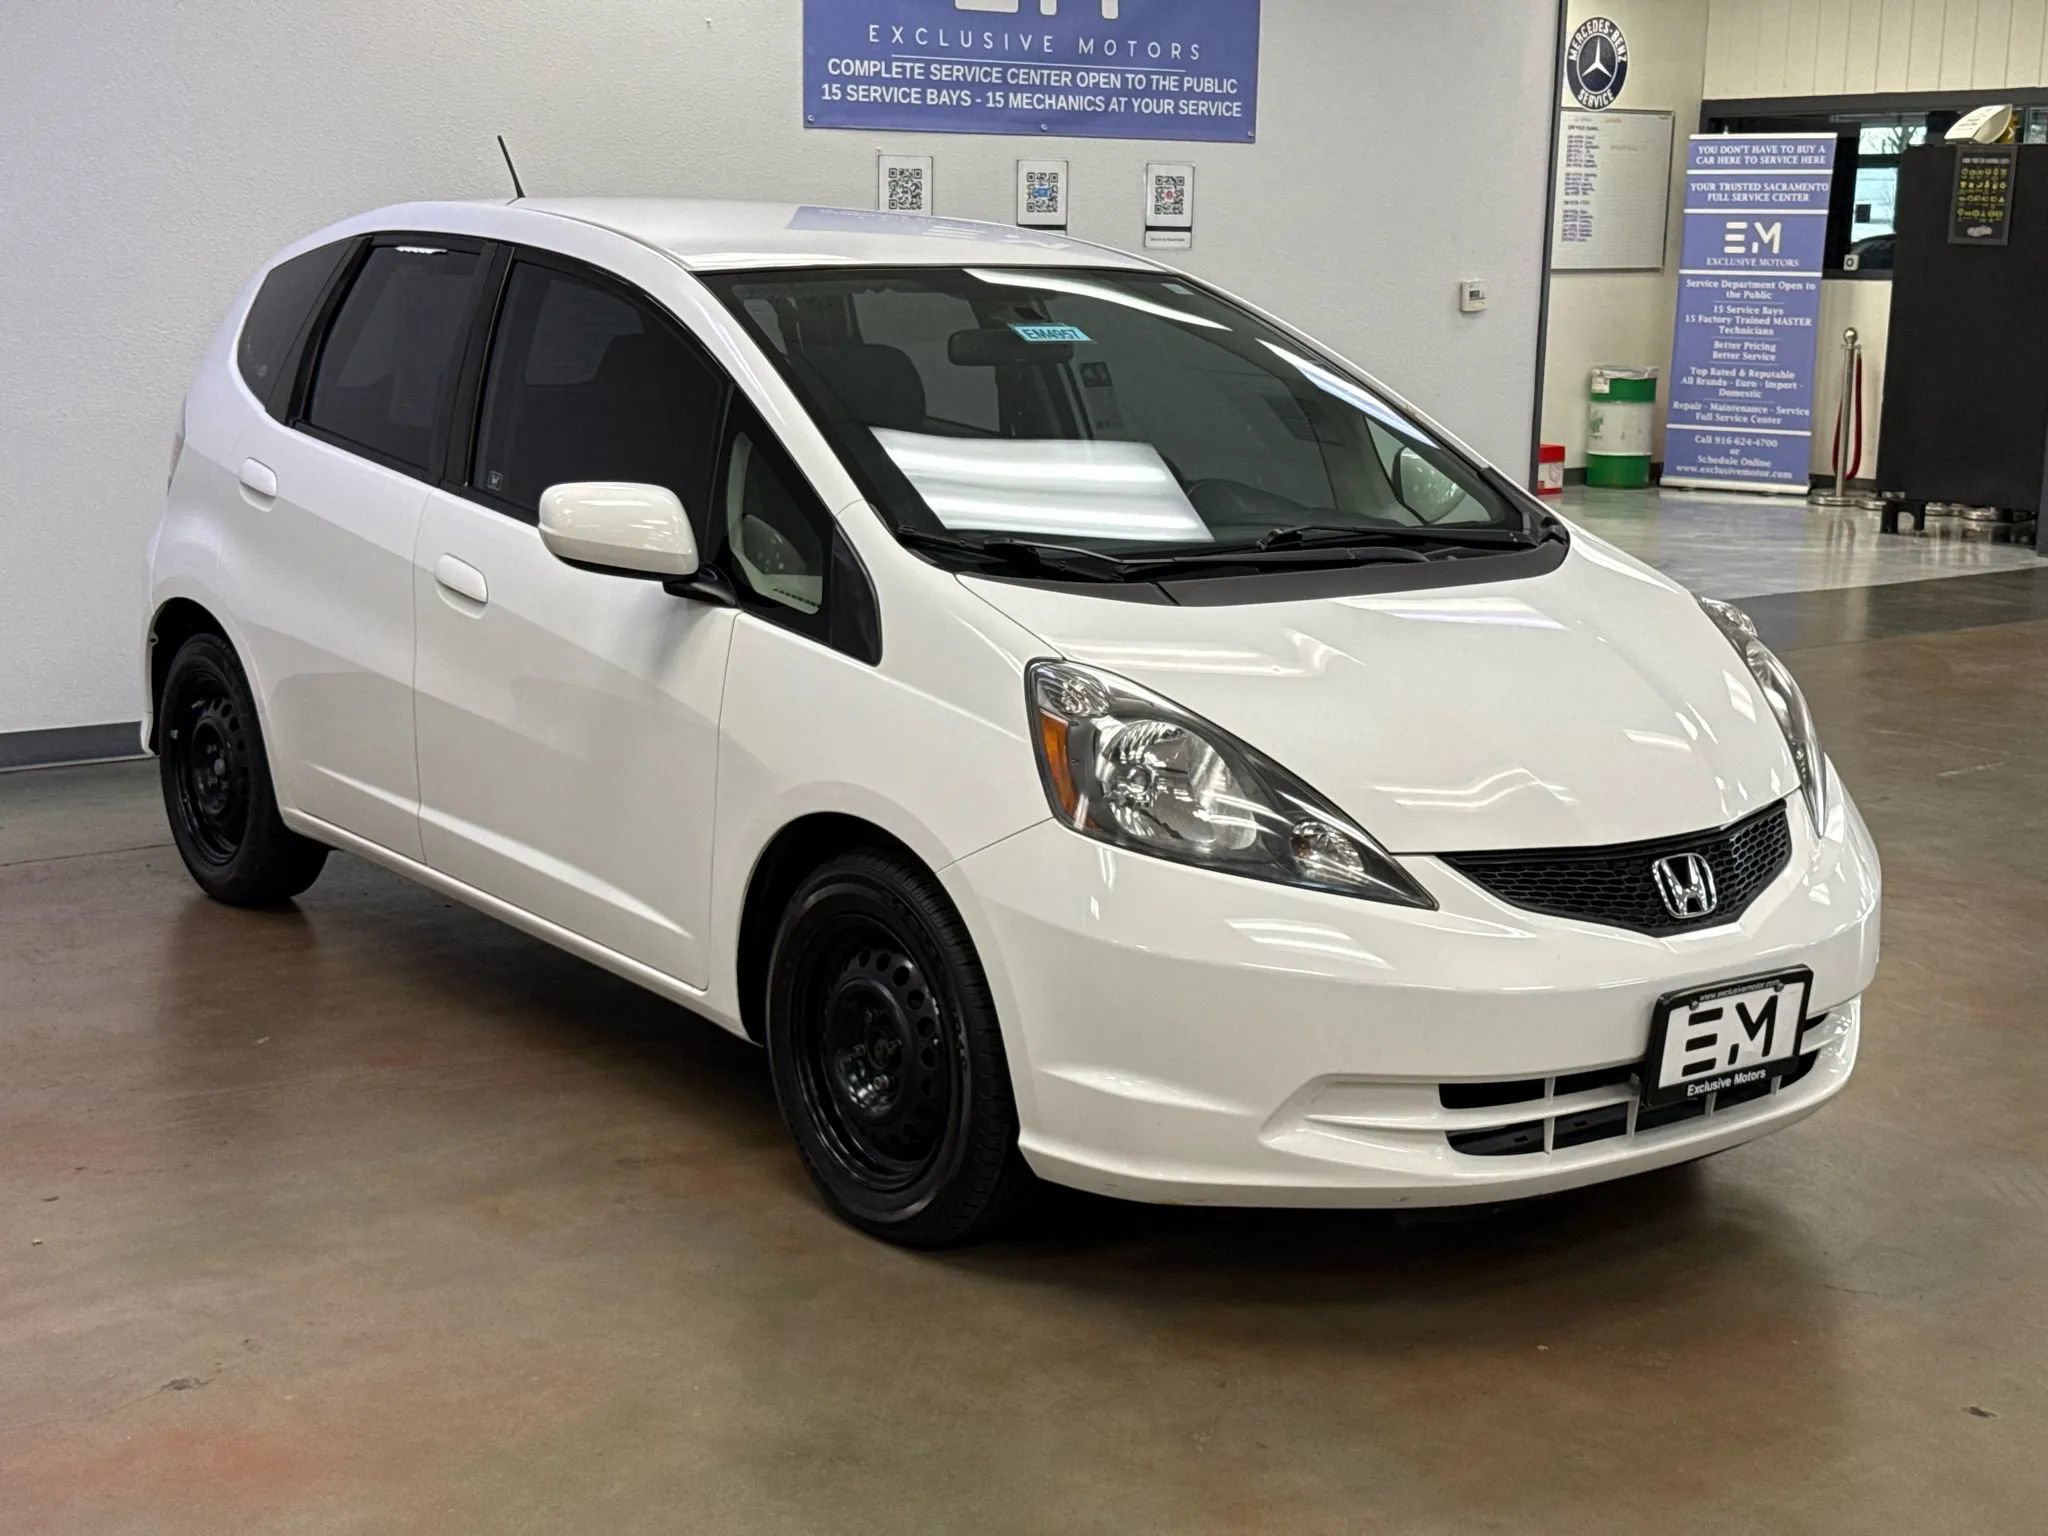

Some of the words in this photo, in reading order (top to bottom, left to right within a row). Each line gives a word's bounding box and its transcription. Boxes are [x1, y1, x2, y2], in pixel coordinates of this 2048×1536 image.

[869, 24, 1054, 53] EXCLUSIVE
[1079, 37, 1200, 61] MOTORS
[827, 58, 926, 80] COMPLETE
[930, 65, 1003, 84] SERVICE
[1007, 68, 1073, 87] CENTER
[1076, 71, 1122, 90] OPEN
[1125, 74, 1147, 91] TO
[1150, 75, 1180, 92] THE
[1184, 76, 1238, 95] PUBLIC
[821, 83, 842, 101] 15
[846, 85, 922, 104] SERVICE
[926, 89, 972, 107] BAYS
[985, 91, 1005, 108] 15
[1009, 93, 1105, 112] MECHANICS
[1108, 97, 1129, 113] AT
[1131, 98, 1175, 115] YOUR
[1178, 101, 1243, 117] SERVICE
[1577, 89, 1615, 109] SERVICE
[1698, 146, 1718, 155] YOU
[1719, 145, 1748, 155] DON'T
[1750, 145, 1779, 154] HAVE
[1780, 145, 1794, 154] TO
[1796, 145, 1815, 154] BUY
[1817, 145, 1826, 154] A
[1696, 156, 1716, 165] CAR
[1717, 156, 1742, 165] HERE
[1744, 156, 1758, 165] TO
[1760, 156, 1799, 165] SERVICE
[1800, 156, 1826, 165] HERE
[1690, 183, 1716, 192] YOUR
[1719, 183, 1761, 192] TRUSTED
[1763, 183, 1829, 192] SACRAMENTO
[1707, 193, 1730, 202] FULL
[1732, 193, 1770, 202] SERVICE
[1772, 193, 1809, 202] CENTER
[1724, 222, 1782, 254] EM
[1706, 258, 1757, 267] EXCLUSIVE
[1759, 258, 1800, 267] MOTORS
[1686, 279, 1719, 289] Service
[1721, 280, 1776, 291] Department
[1778, 281, 1803, 291] Open
[1806, 282, 1817, 290] to
[1726, 290, 1741, 299] the
[1744, 290, 1773, 300] Public
[1713, 305, 1724, 314] 15
[1726, 305, 1760, 315] Service
[1762, 306, 1784, 316] Bays
[1685, 314, 1695, 323] 15
[1698, 315, 1733, 325] Factory
[1735, 316, 1770, 325] Trained
[1773, 317, 1812, 327] MASTER
[1719, 325, 1775, 336] Technicians
[1713, 340, 1741, 350] Better
[1743, 342, 1777, 353] Pricing
[1712, 350, 1741, 360] Better
[1742, 351, 1776, 361] Service
[1690, 366, 1708, 377] Top
[1710, 367, 1736, 377] Rated
[1738, 368, 1746, 377] &
[1748, 369, 1796, 380] Reputable
[1735, 379, 1757, 388] Euro
[1765, 380, 1797, 391] Import
[1718, 389, 1763, 399] Domestic
[1672, 401, 1702, 412] Repair
[1710, 402, 1768, 415] Maintenance
[1776, 406, 1810, 417] Service
[1715, 413, 1748, 424] Service
[1694, 435, 1713, 445] Call
[1681, 994, 1778, 1078] EM
[1686, 1076, 1732, 1097] Exclusive
[1733, 1068, 1767, 1086] Motors
